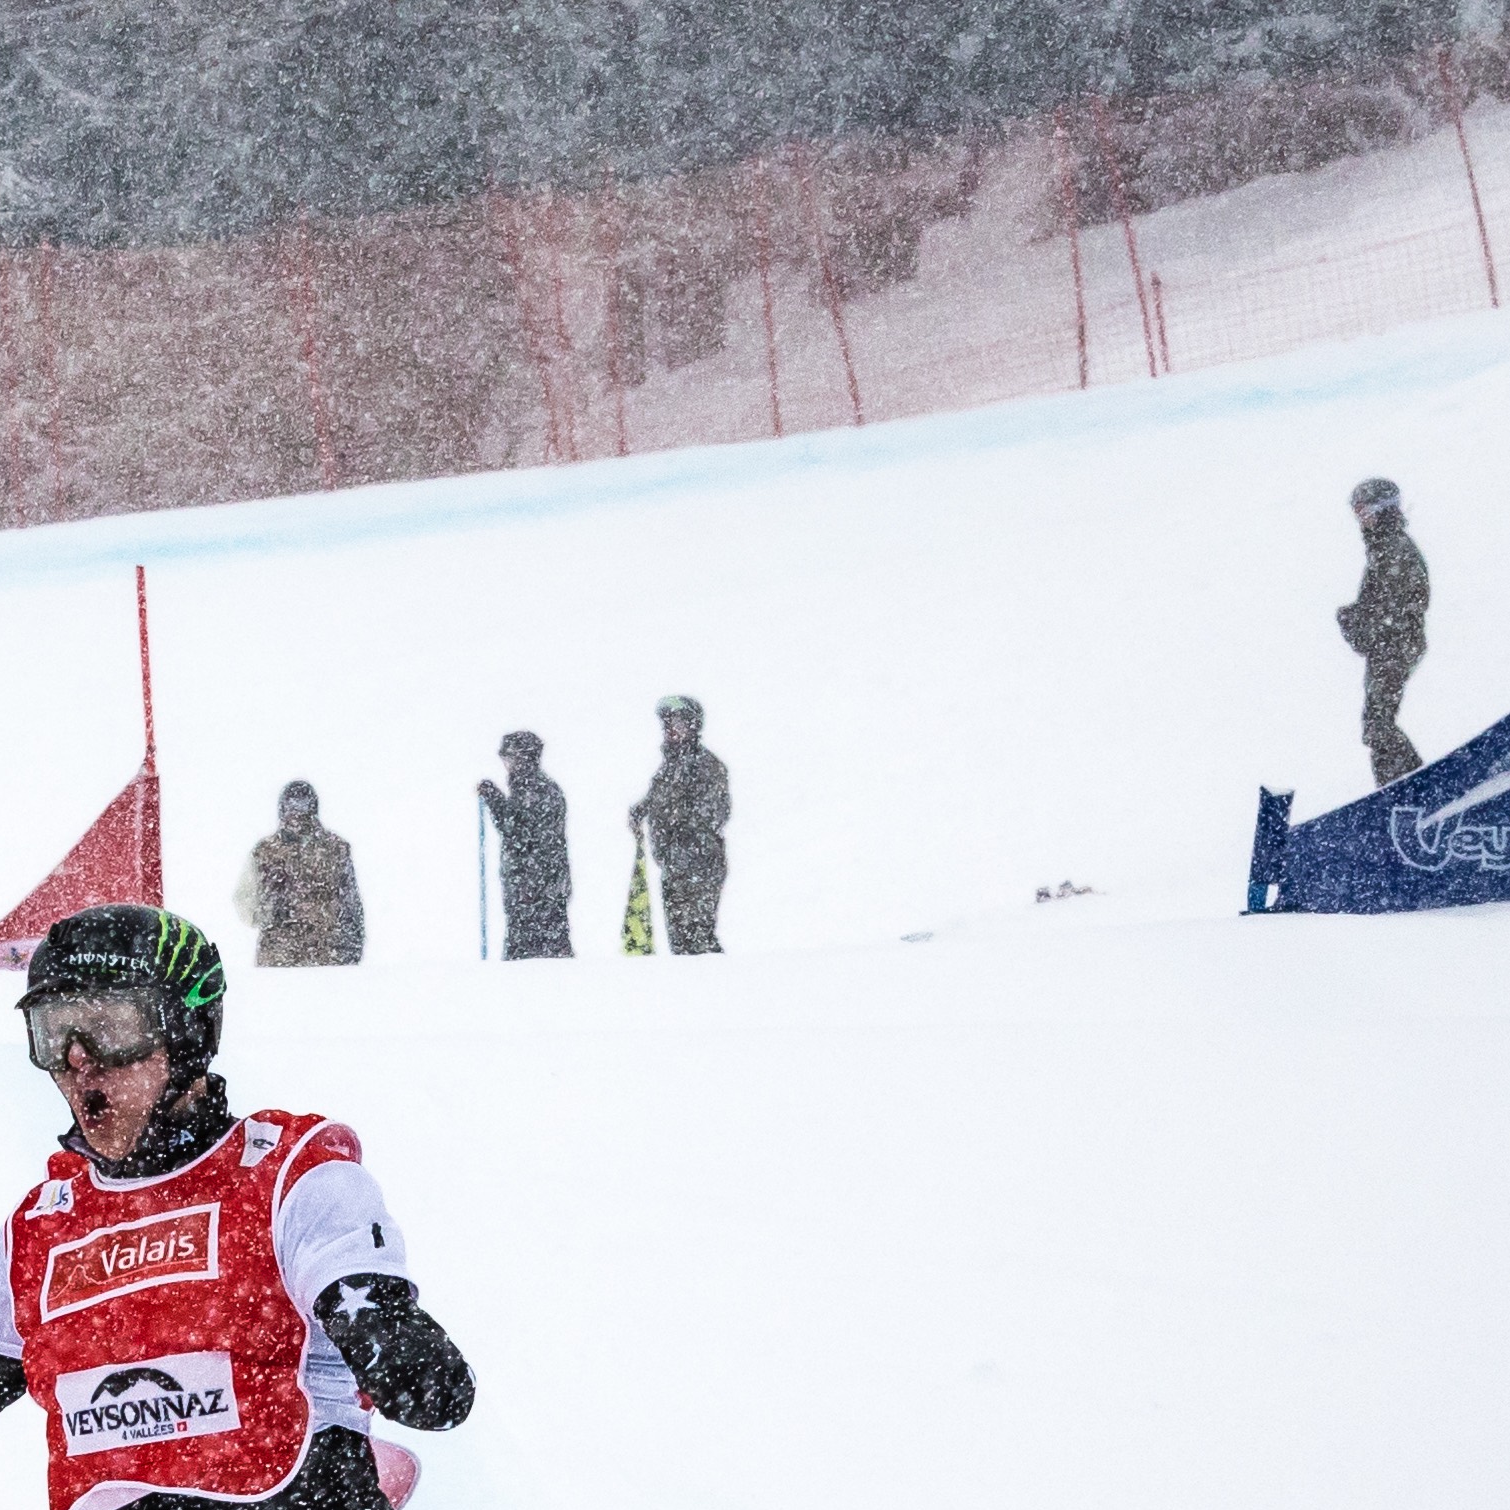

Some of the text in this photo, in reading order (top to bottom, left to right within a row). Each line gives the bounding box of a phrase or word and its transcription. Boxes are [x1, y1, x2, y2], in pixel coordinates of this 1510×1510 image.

[68, 951, 151, 975] MONSTER
[101, 1230, 195, 1277] Valais
[66, 1388, 229, 1437] VEYSONNAZ
